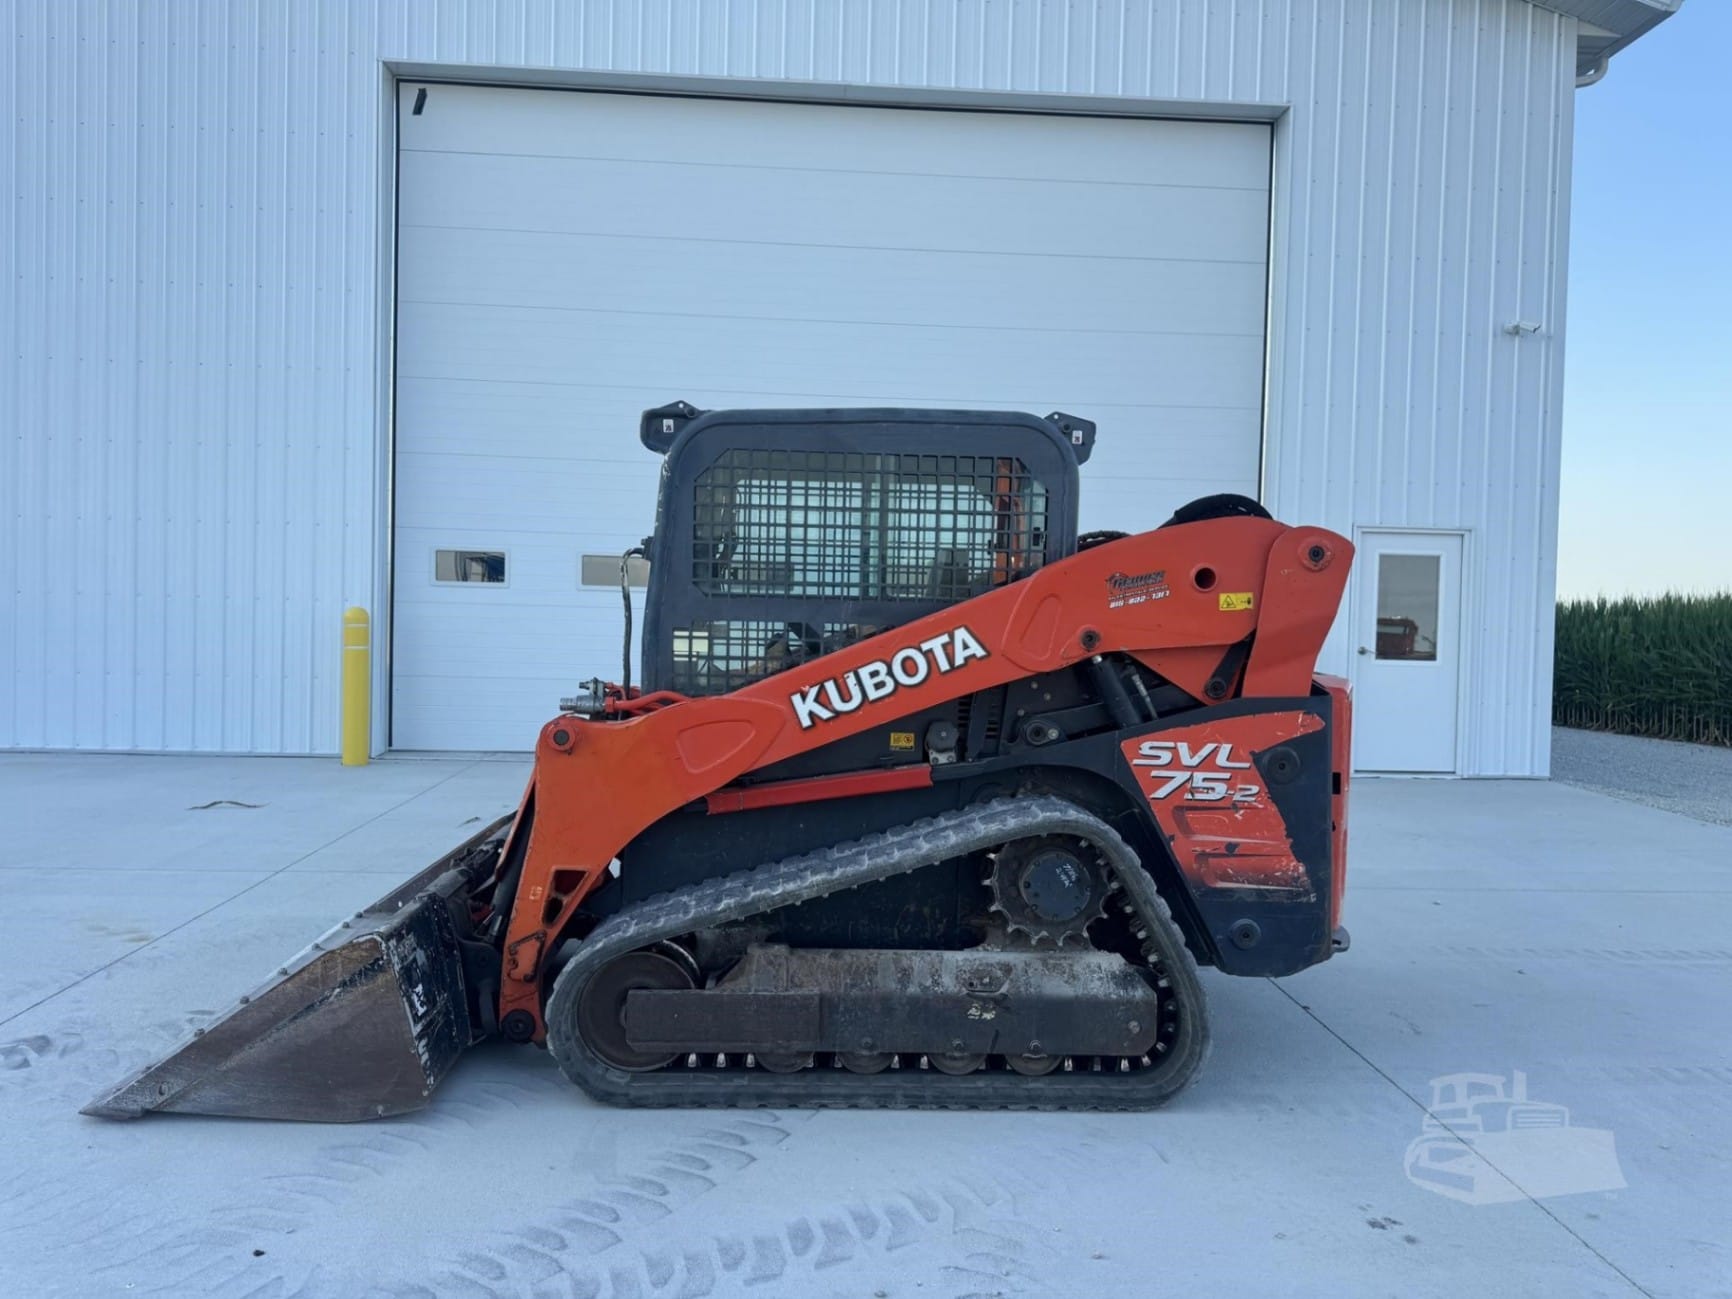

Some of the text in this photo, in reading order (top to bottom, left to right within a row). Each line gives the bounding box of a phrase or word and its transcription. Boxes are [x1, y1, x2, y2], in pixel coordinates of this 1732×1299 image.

[790, 626, 989, 729] KUBOTA
[1132, 741, 1251, 769] SVL
[1149, 770, 1260, 801] 75-2
